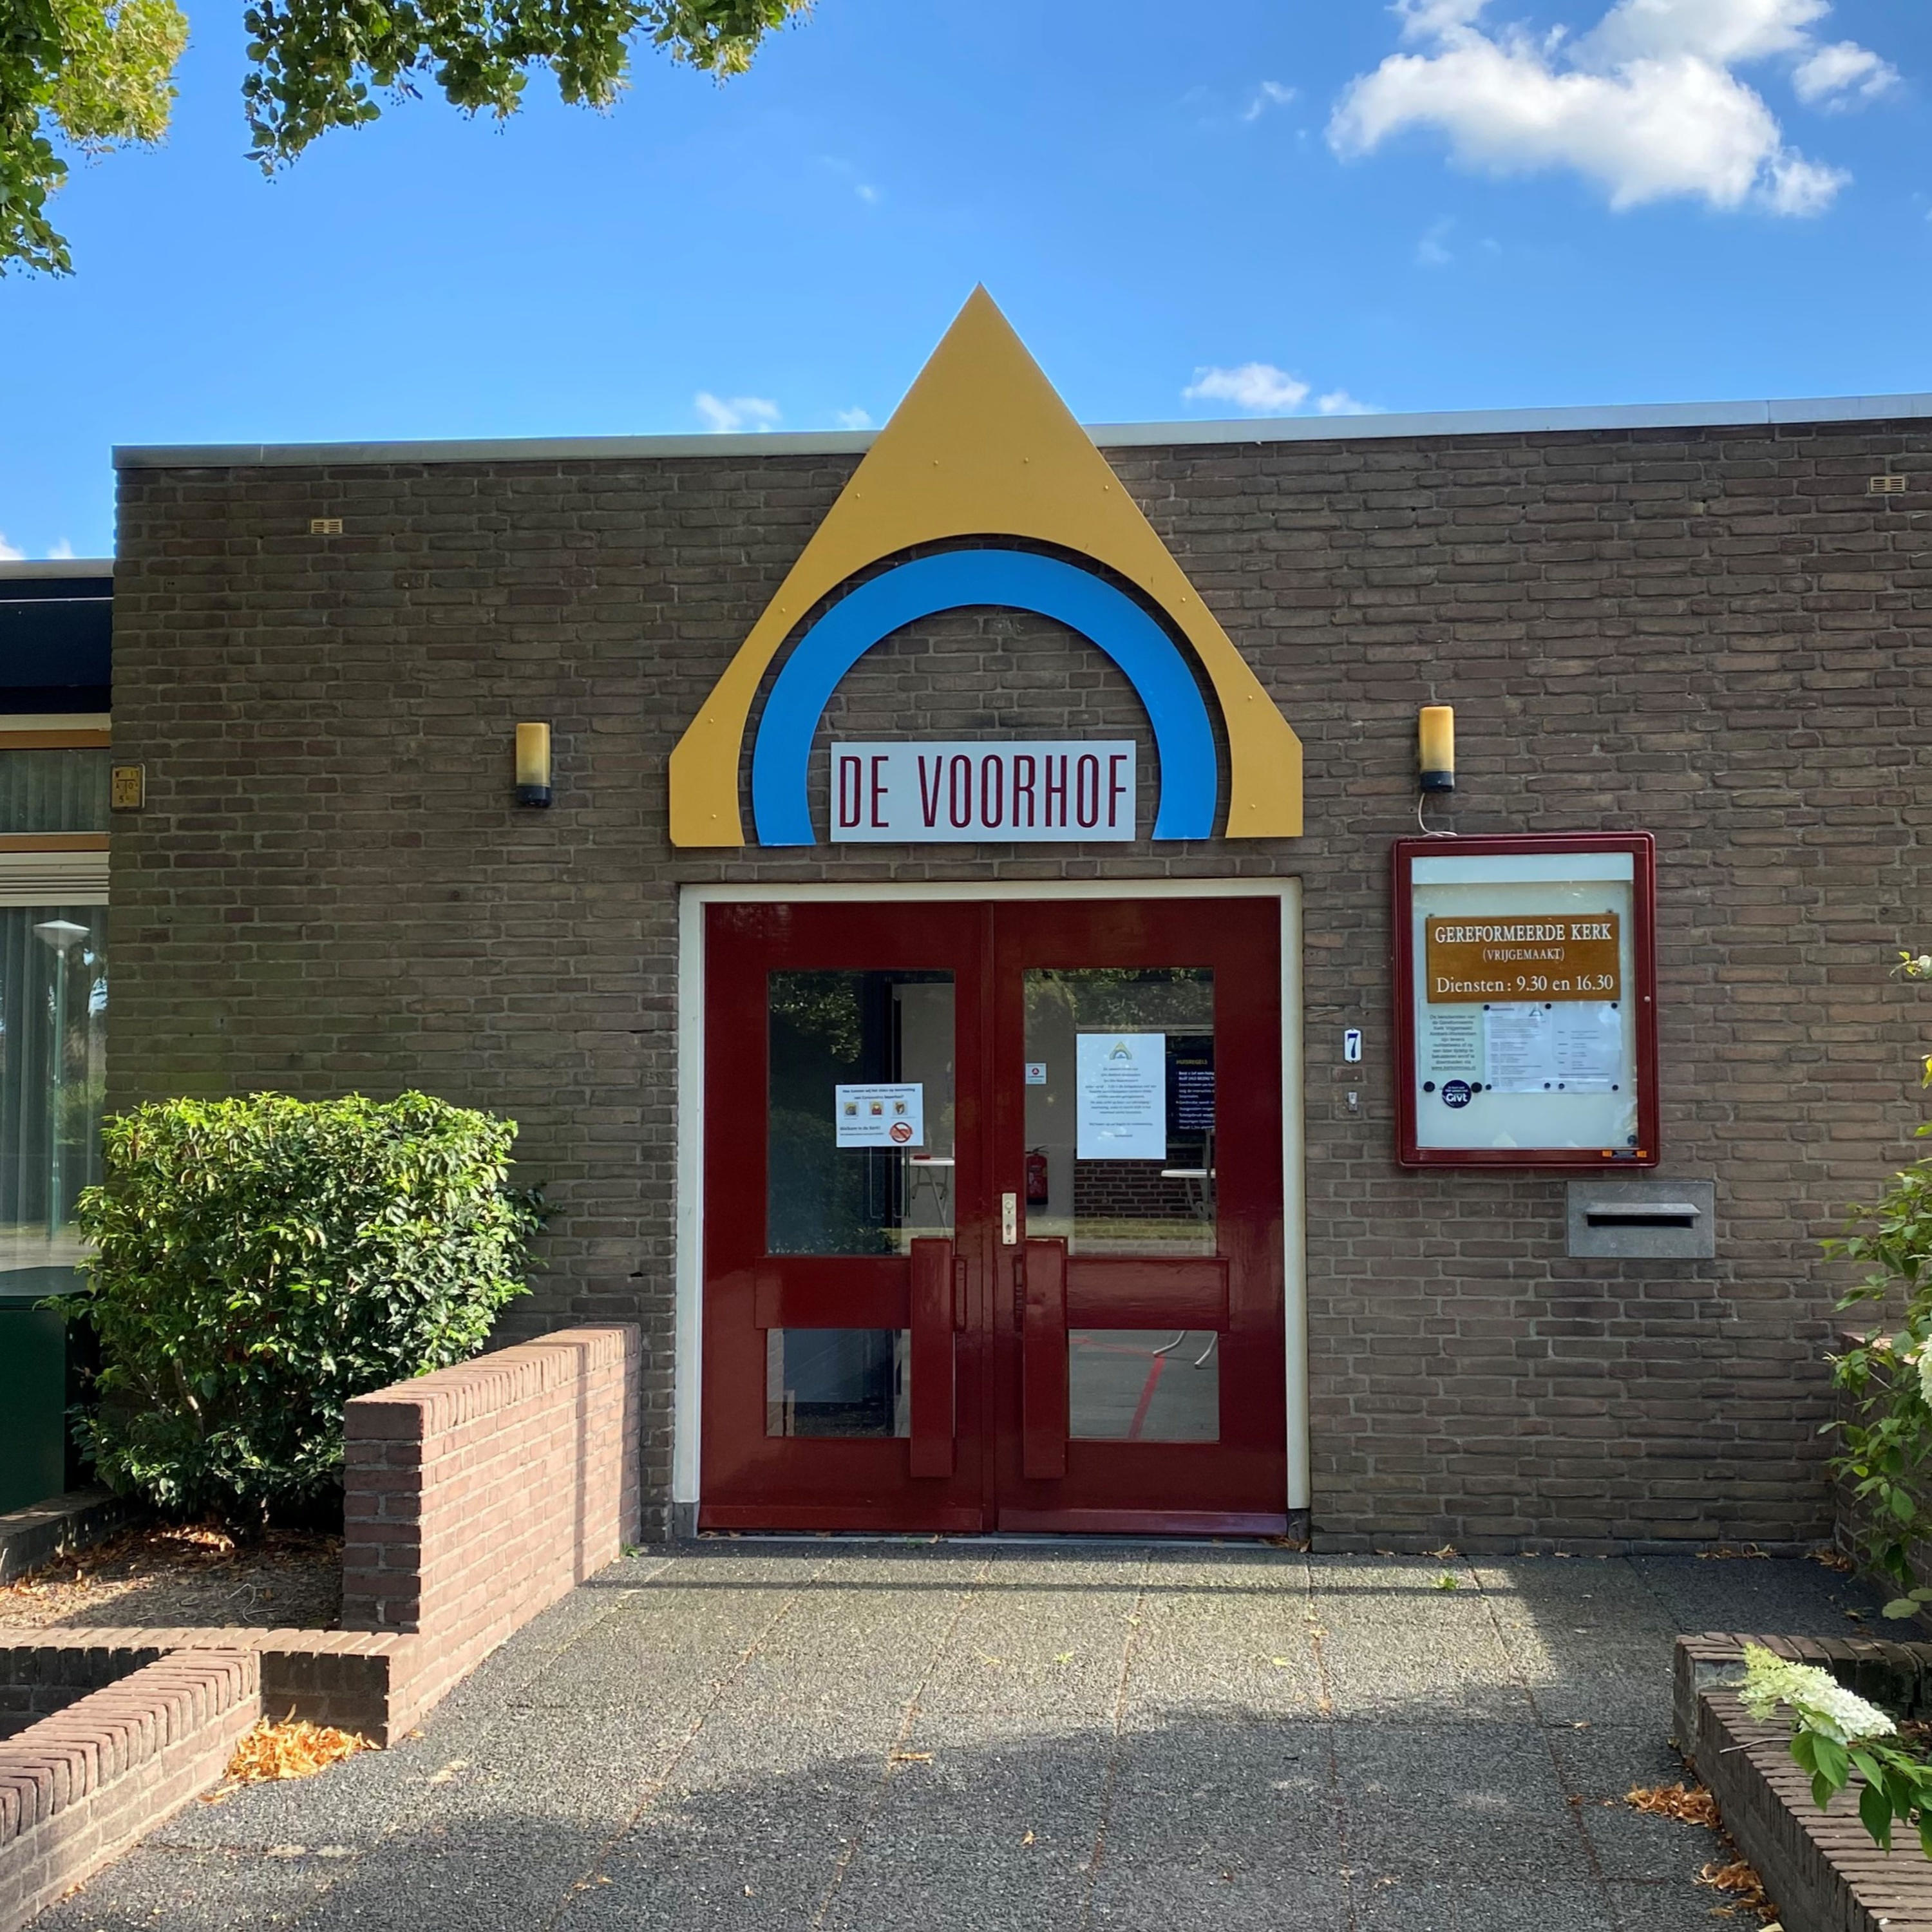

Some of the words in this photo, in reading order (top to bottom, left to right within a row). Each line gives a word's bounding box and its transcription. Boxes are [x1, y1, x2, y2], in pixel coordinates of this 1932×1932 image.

[840, 756, 889, 828] DE
[918, 754, 1128, 828] VOORHOF
[1435, 924, 1566, 943] GEREFORMEERDE
[1571, 923, 1612, 940] KERK
[1482, 947, 1565, 963] (VRIJGEMAAKT)
[1517, 976, 1547, 992] 9.30
[1552, 979, 1570, 990] en
[1576, 974, 1613, 990] 16.30
[1347, 1033, 1359, 1059] 7
[1446, 1093, 1468, 1102] Givt
